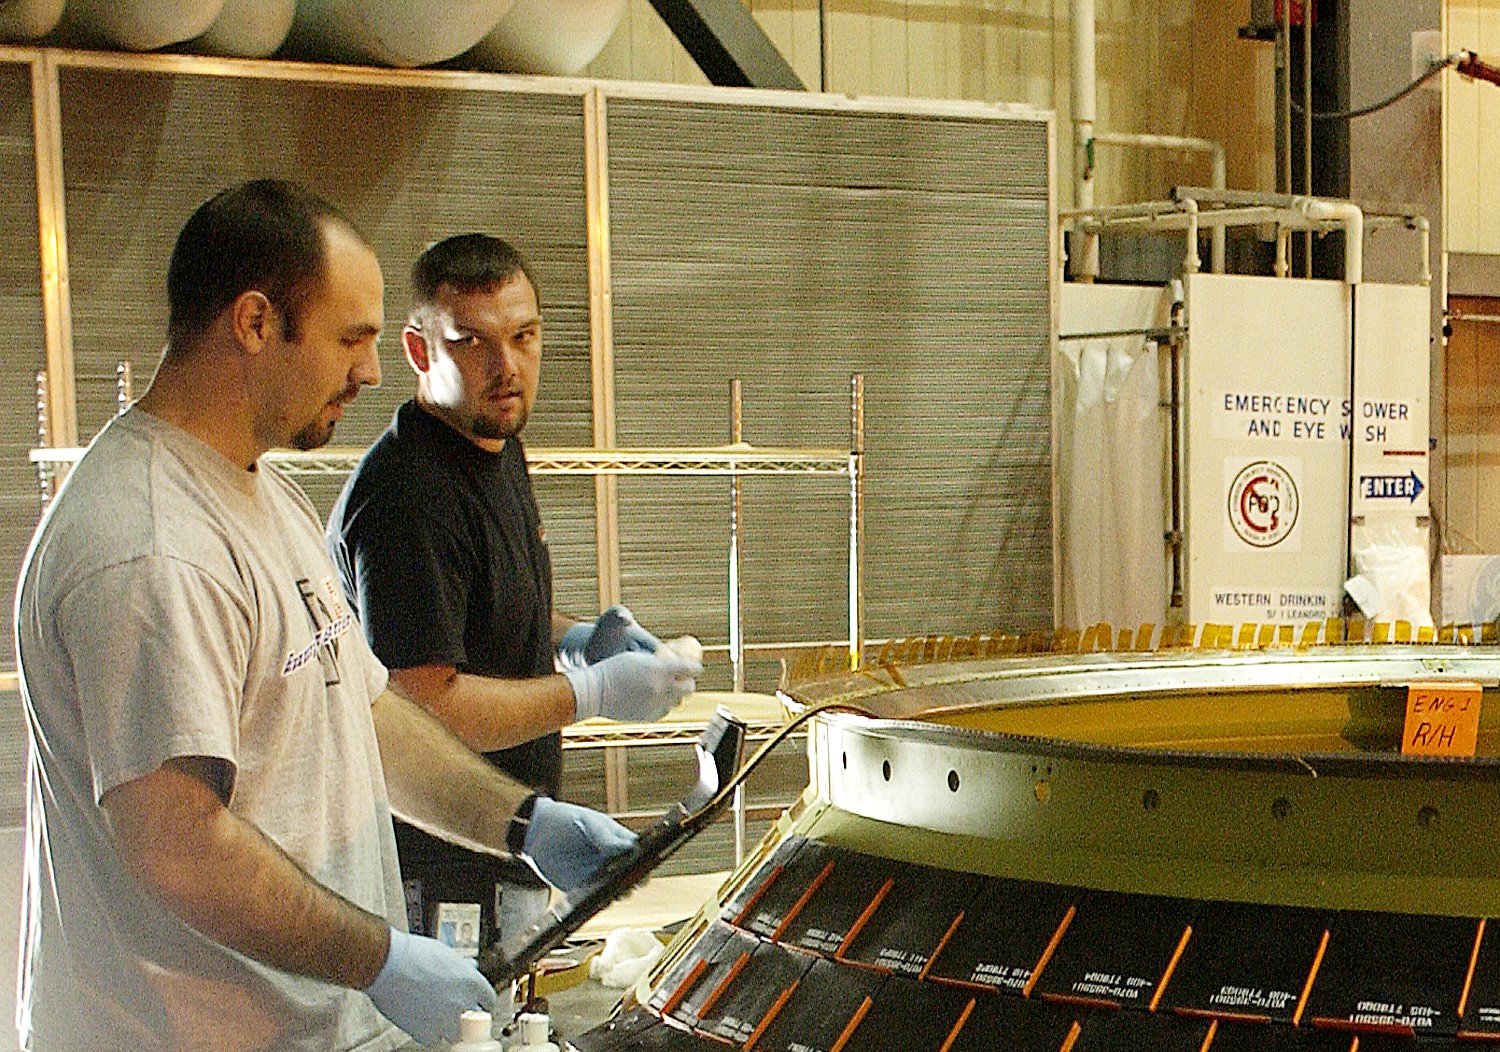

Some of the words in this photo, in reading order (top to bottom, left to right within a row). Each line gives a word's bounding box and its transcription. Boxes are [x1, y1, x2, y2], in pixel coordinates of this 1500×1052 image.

[1342, 399, 1409, 421] SOWER
[1248, 419, 1281, 437] AND
[1294, 421, 1325, 439] EYE
[1340, 424, 1387, 442] WSH
[1364, 478, 1415, 498] ENTER
[1215, 593, 1271, 606] WESTERN
[1413, 694, 1455, 713] ENG
[1411, 722, 1457, 748] R/H
